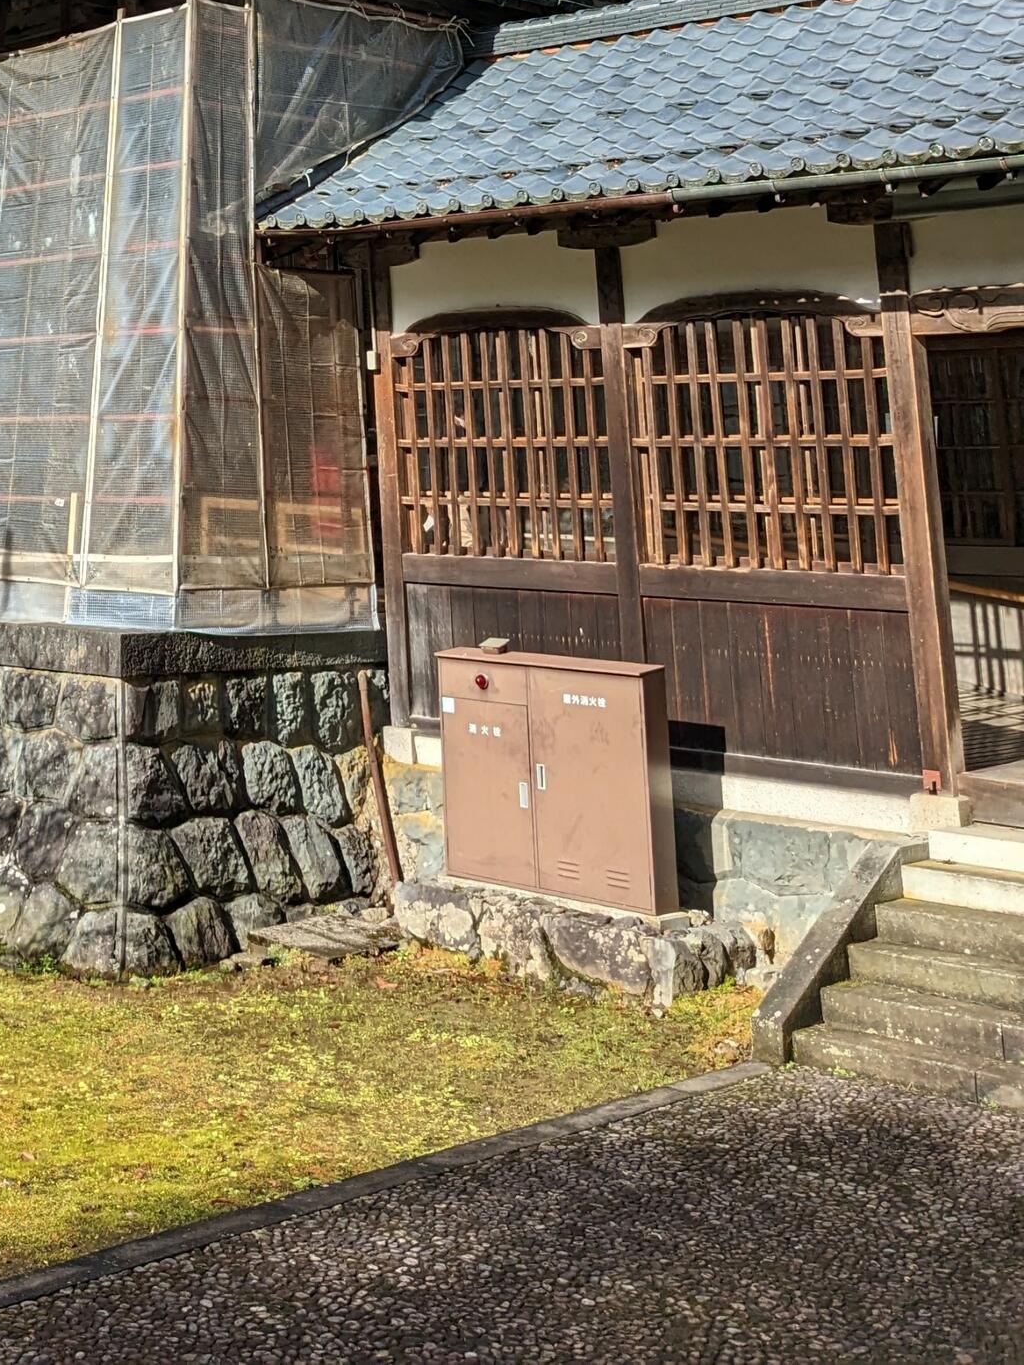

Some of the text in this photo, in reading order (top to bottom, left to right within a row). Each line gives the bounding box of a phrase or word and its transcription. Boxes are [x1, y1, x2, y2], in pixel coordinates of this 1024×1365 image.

[562, 693, 607, 708] 屋外消火栓
[468, 723, 501, 737] 消火栓
